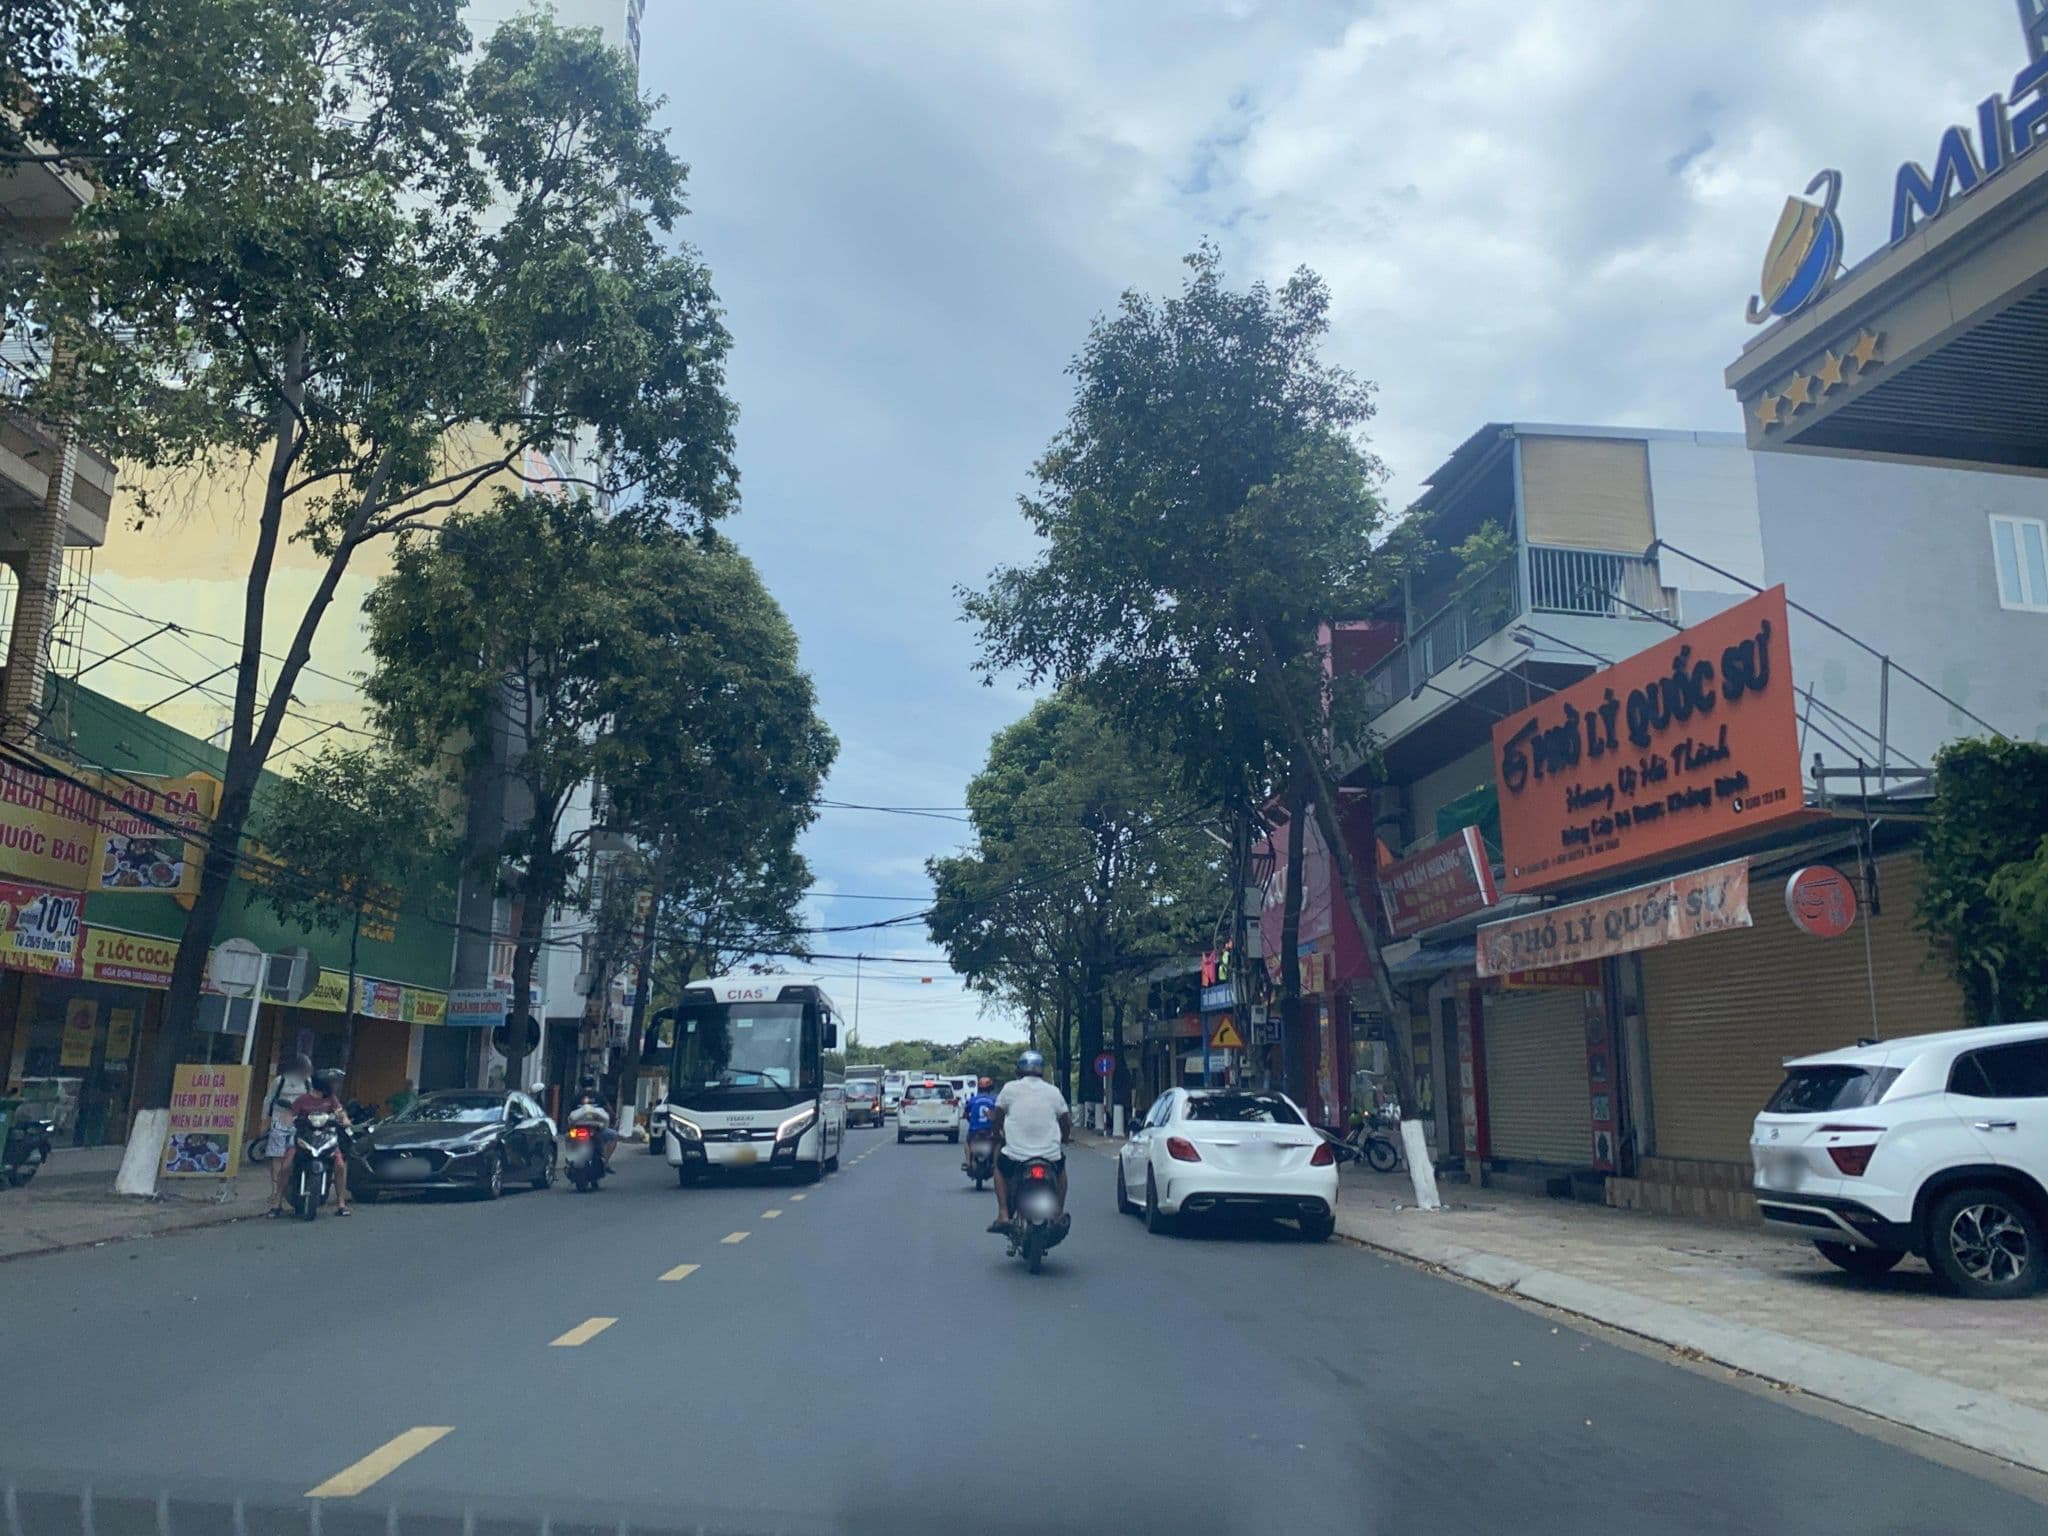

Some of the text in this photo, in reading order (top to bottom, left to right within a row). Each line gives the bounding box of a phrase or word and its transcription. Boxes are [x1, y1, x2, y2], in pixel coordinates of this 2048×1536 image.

[1627, 644, 1715, 749] QUỐC
[1721, 618, 1771, 701] SƯ
[36, 895, 79, 937] 10%
[96, 939, 105, 957] 2
[727, 989, 763, 1000] CIAS
